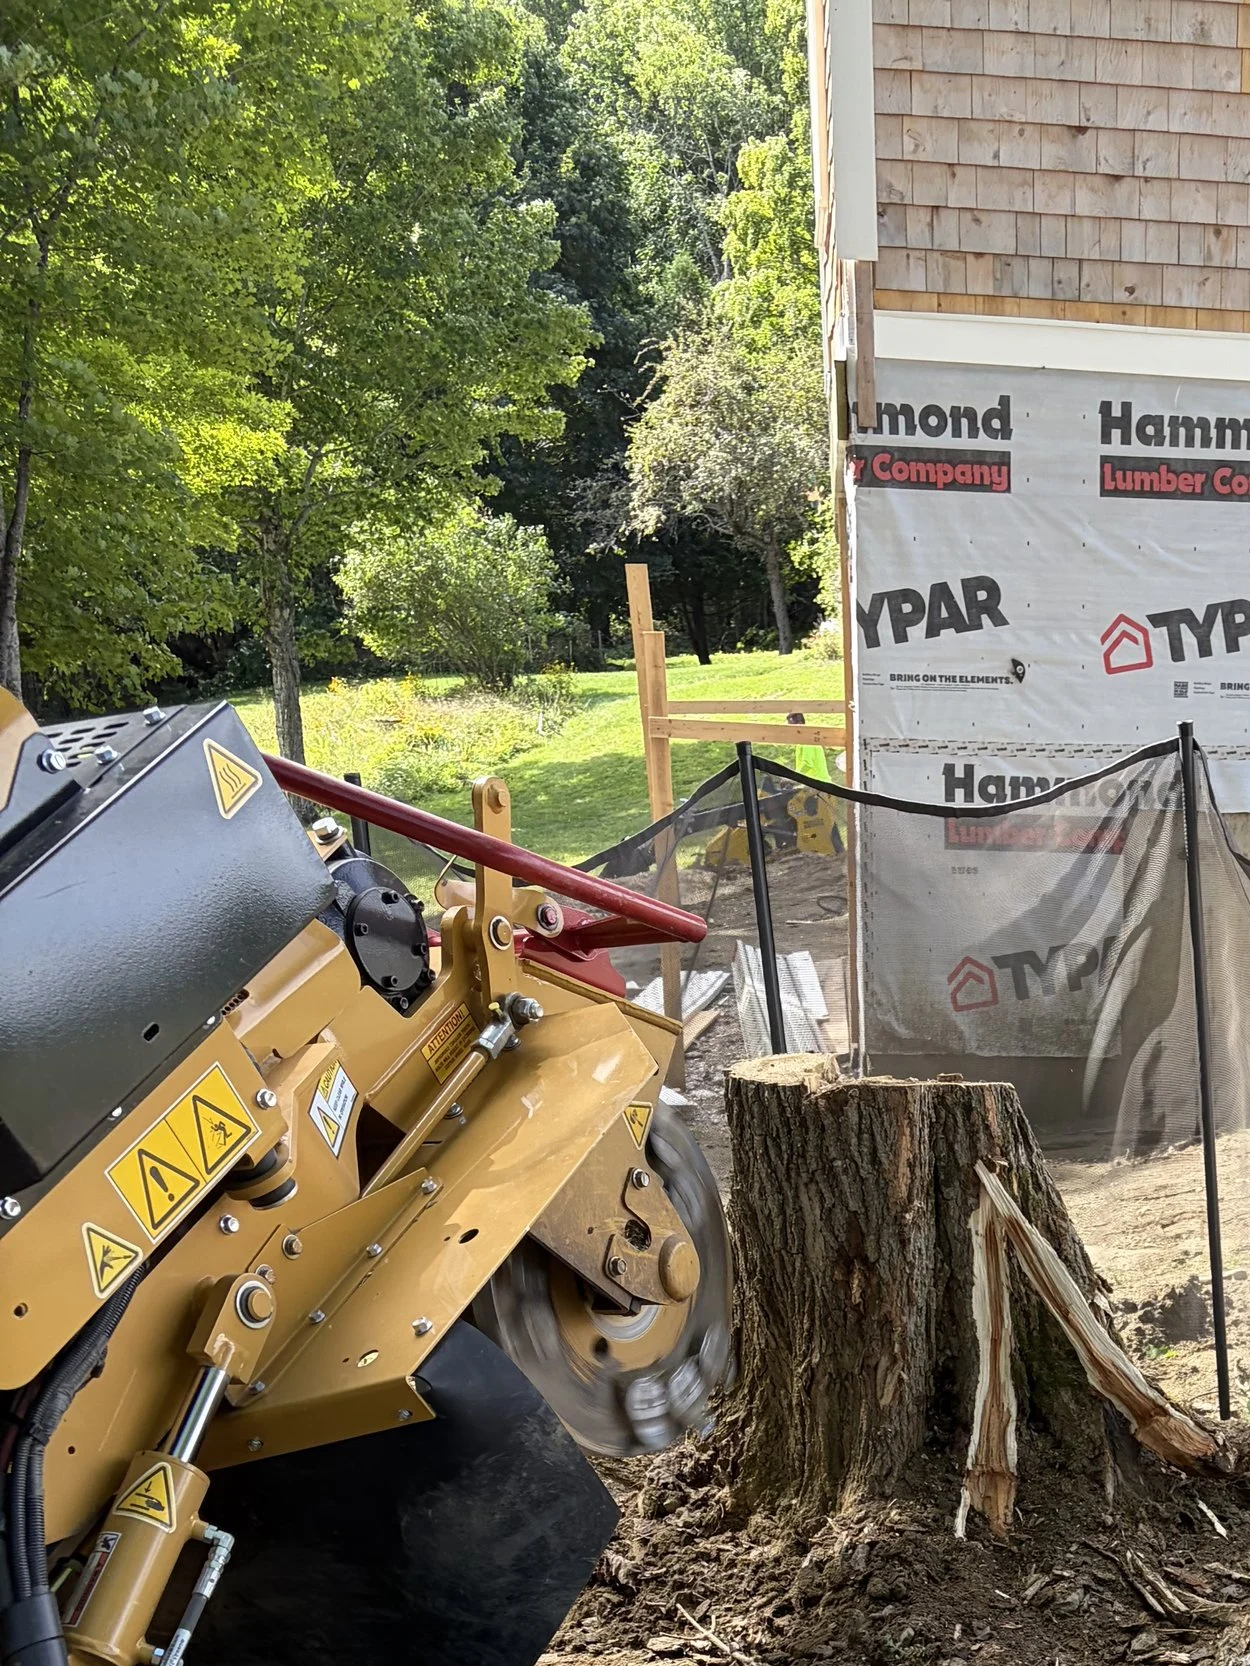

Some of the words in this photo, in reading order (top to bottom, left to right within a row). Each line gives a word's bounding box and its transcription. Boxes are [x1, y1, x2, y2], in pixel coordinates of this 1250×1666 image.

[853, 395, 1013, 440] mond
[872, 452, 1009, 491] Company
[1103, 463, 1206, 494] Lumber
[890, 673, 921, 683] BRING
[922, 674, 937, 683] ON
[938, 674, 957, 684] THE
[959, 675, 1014, 685] ELEMENTS.
[1220, 682, 1250, 691] BRING
[427, 1009, 465, 1054] ATTENTION!
